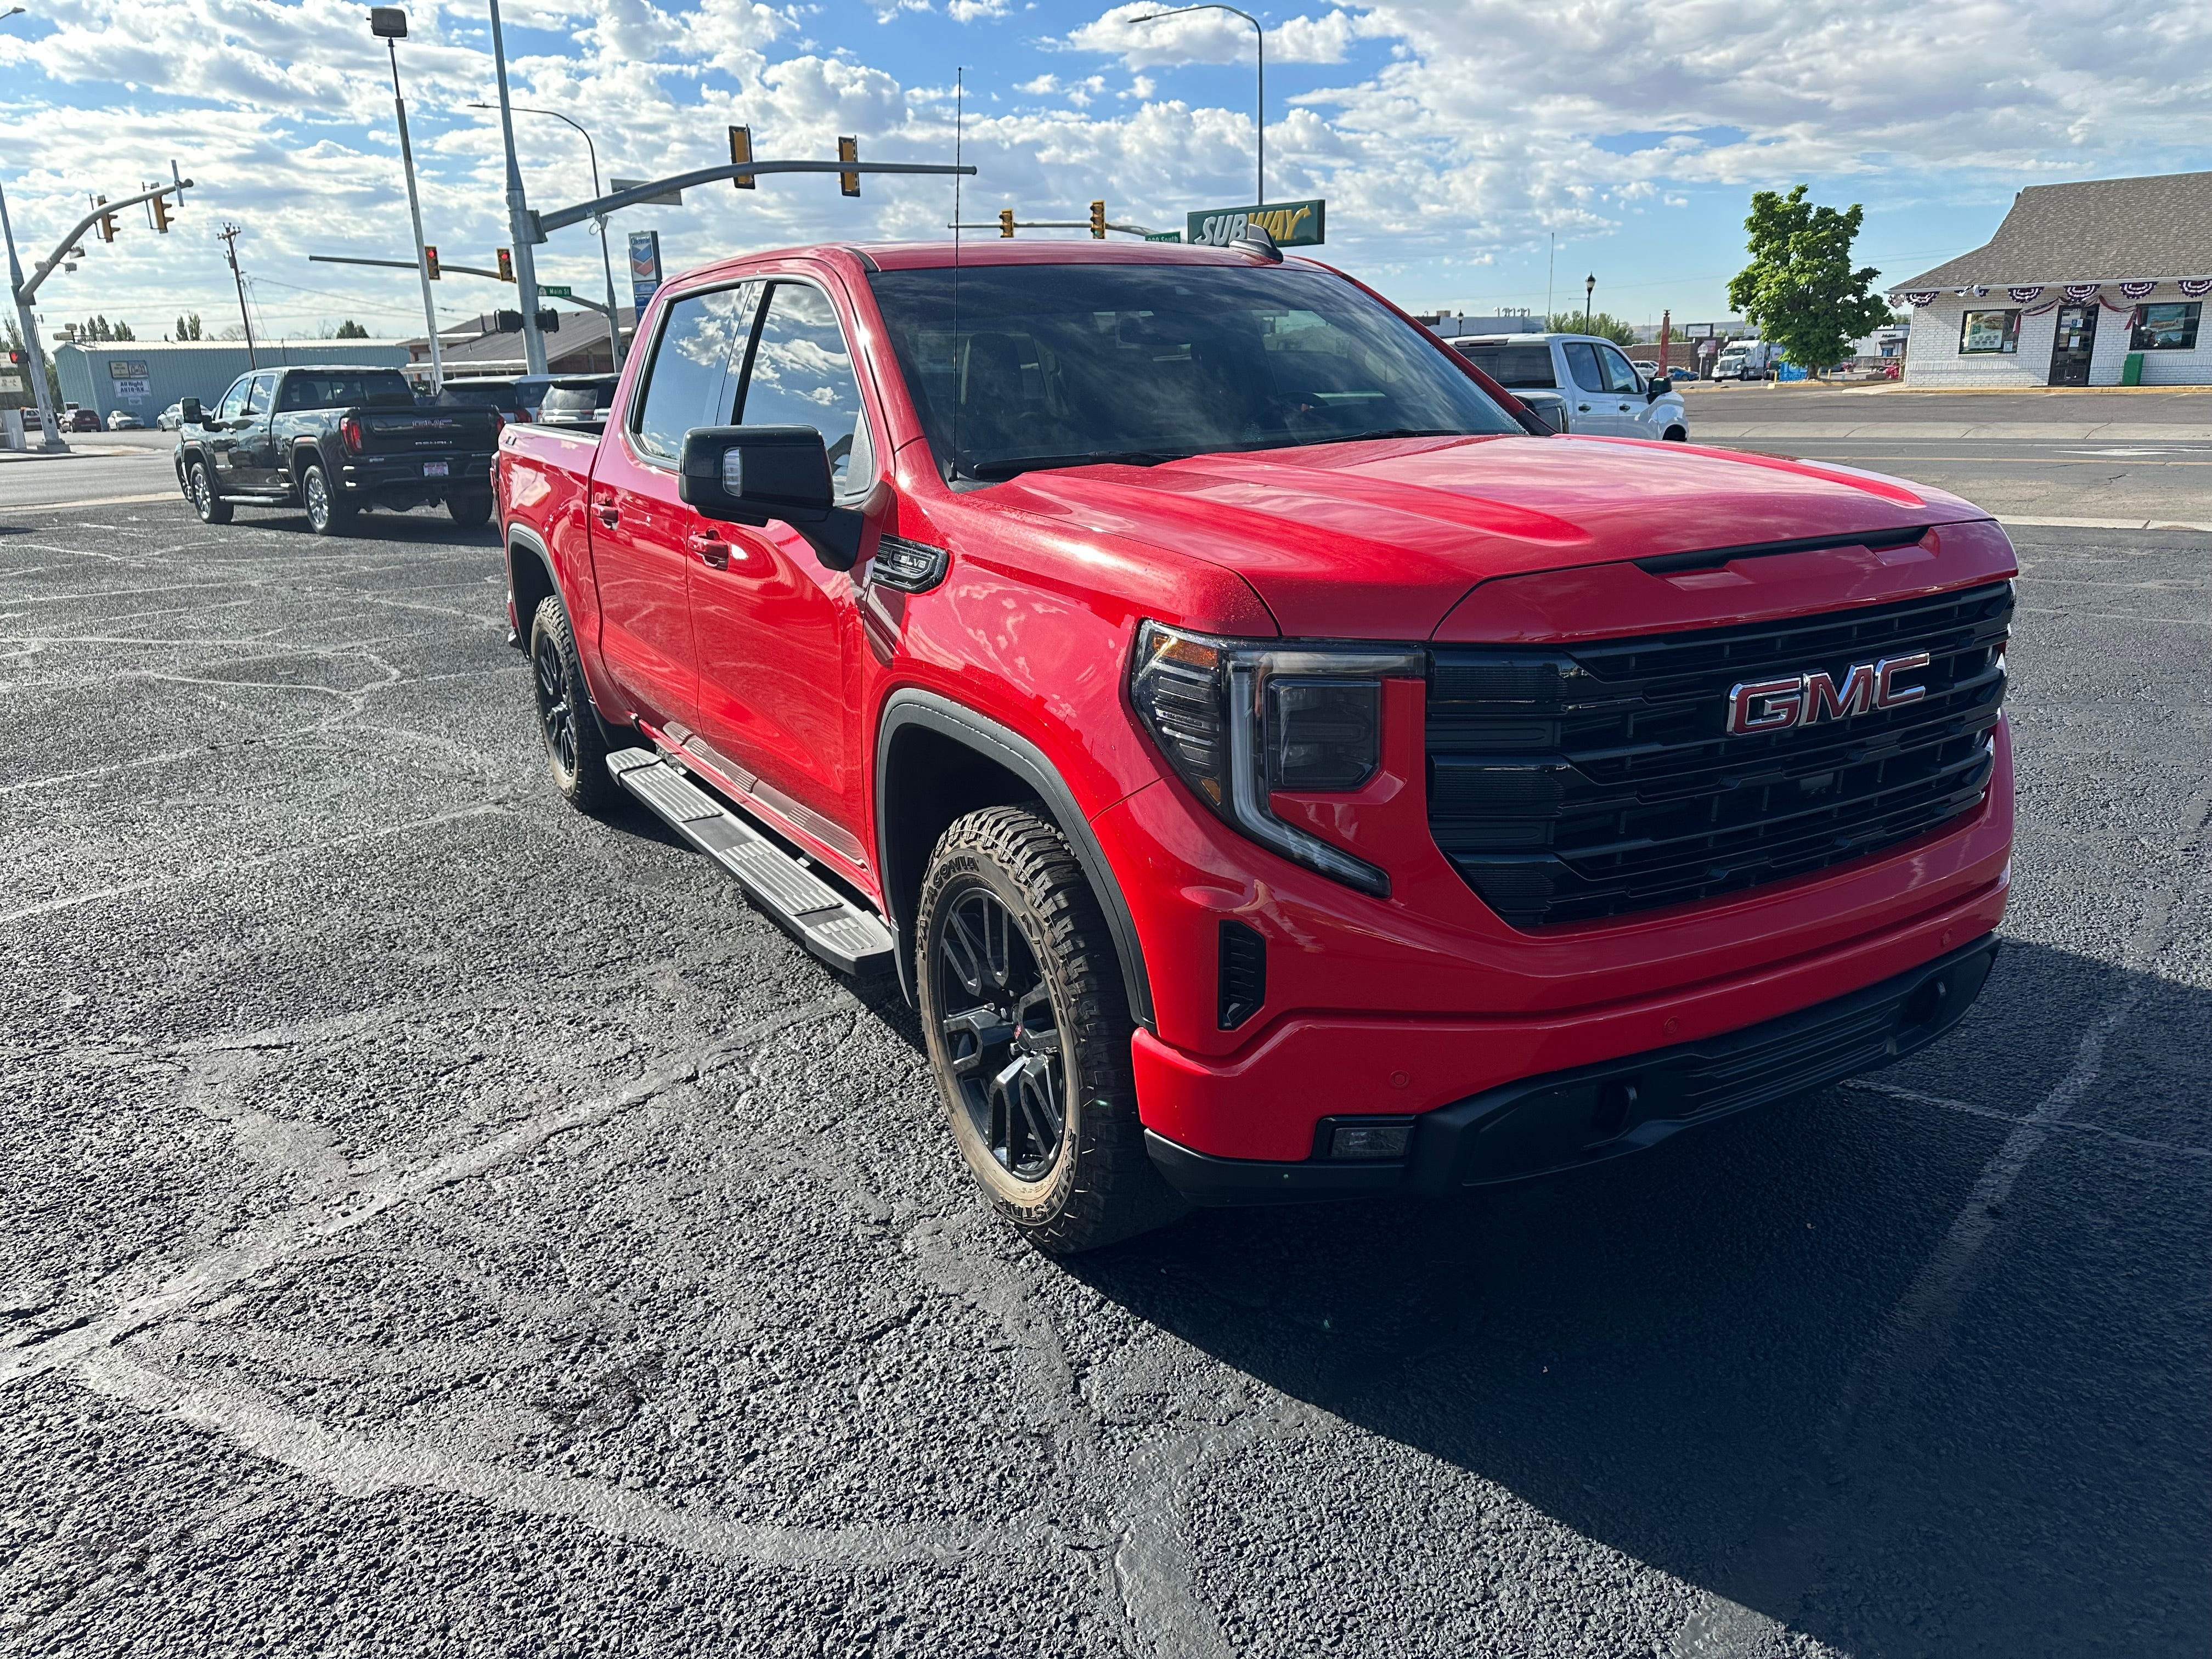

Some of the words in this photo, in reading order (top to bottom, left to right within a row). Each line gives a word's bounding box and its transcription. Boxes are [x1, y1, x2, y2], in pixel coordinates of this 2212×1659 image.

[412, 419, 453, 428] GMC
[913, 558, 927, 569] V8
[1726, 652, 1930, 736] GMC
[917, 855, 980, 962] PATAGONIA
[996, 1126, 1077, 1223] MILESTAR
